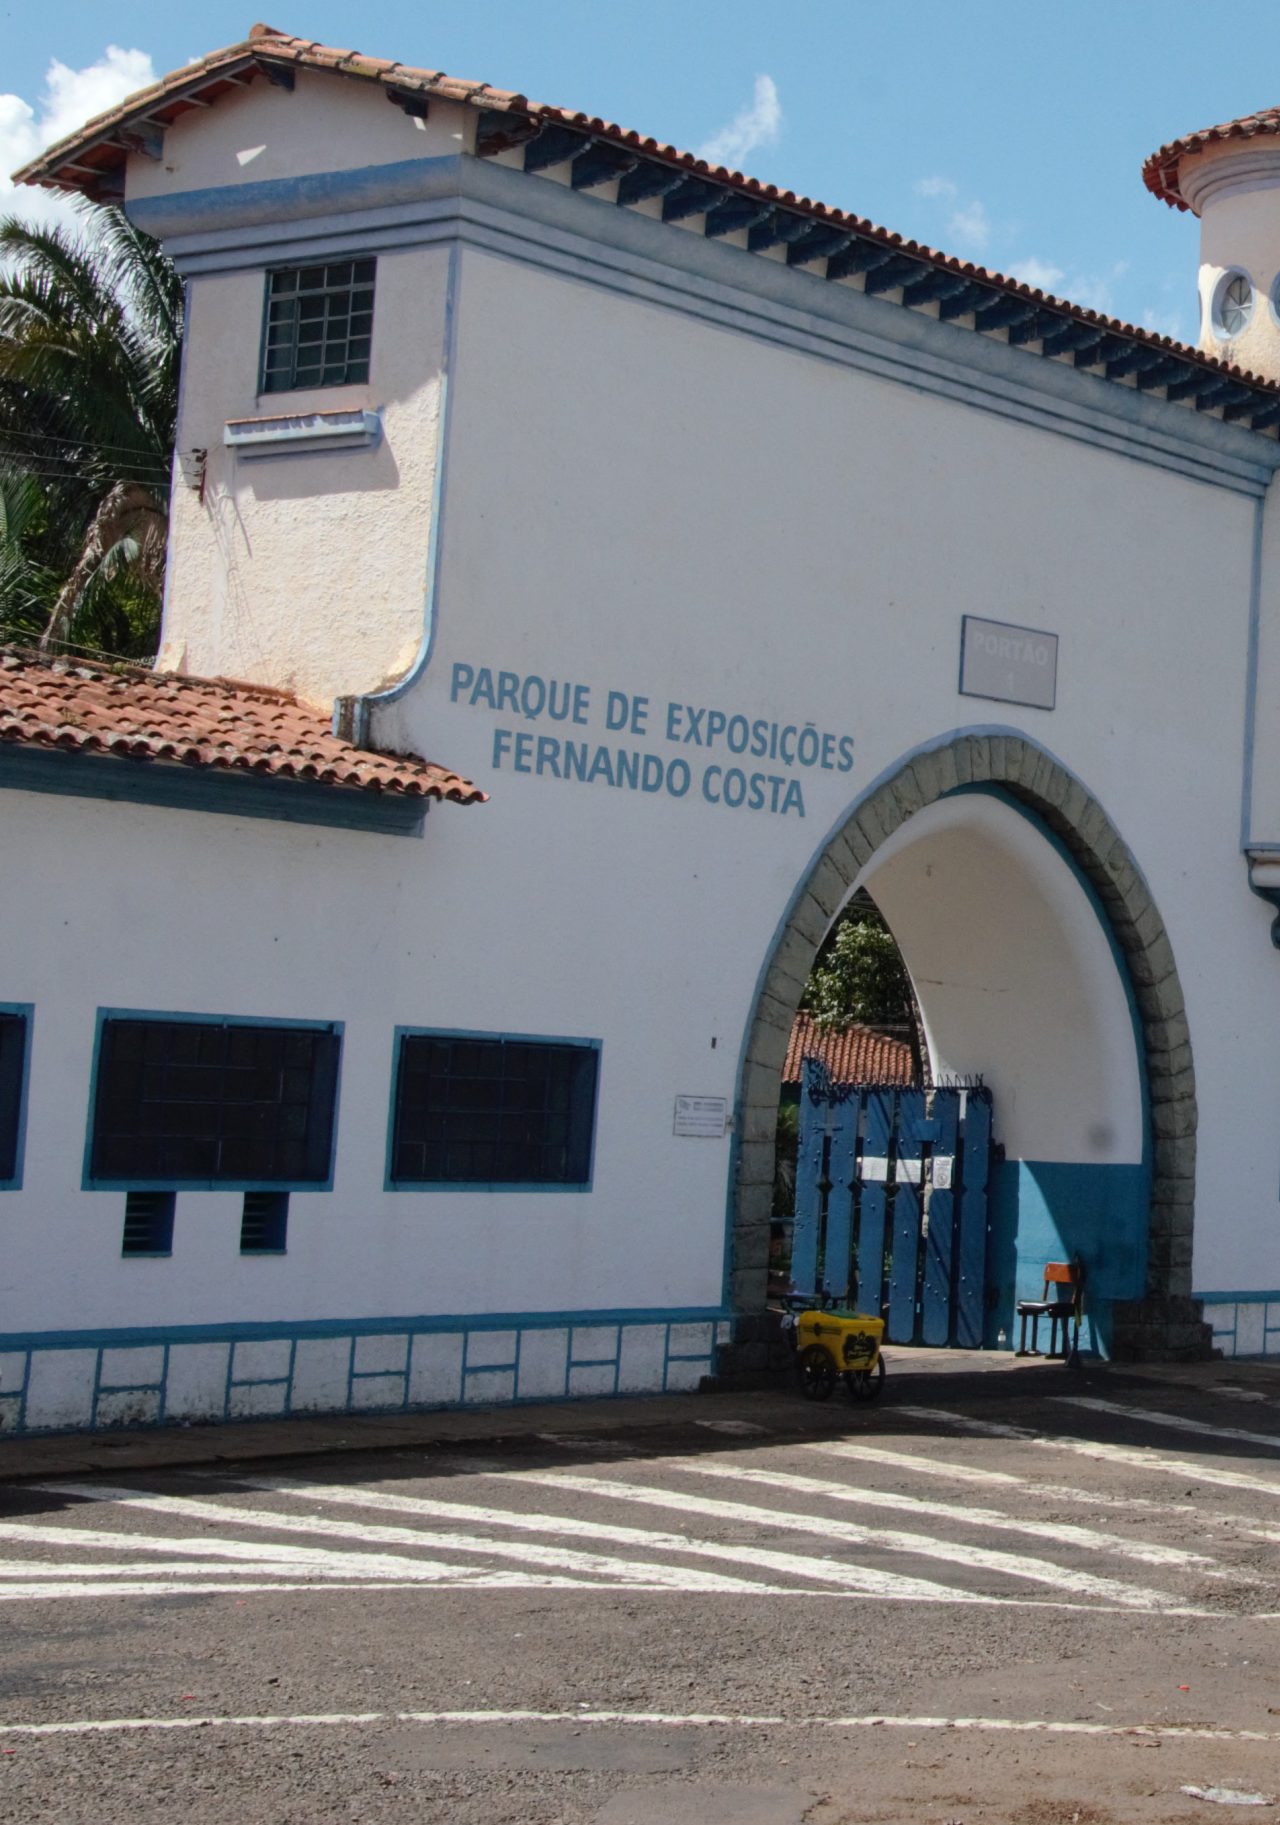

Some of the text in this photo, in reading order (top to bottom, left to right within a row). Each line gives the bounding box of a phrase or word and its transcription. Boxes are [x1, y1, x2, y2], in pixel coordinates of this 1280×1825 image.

[450, 662, 856, 774] PARQUE DE EXPOSIÇÕES
[491, 728, 806, 818] FERNANDO COSTA
